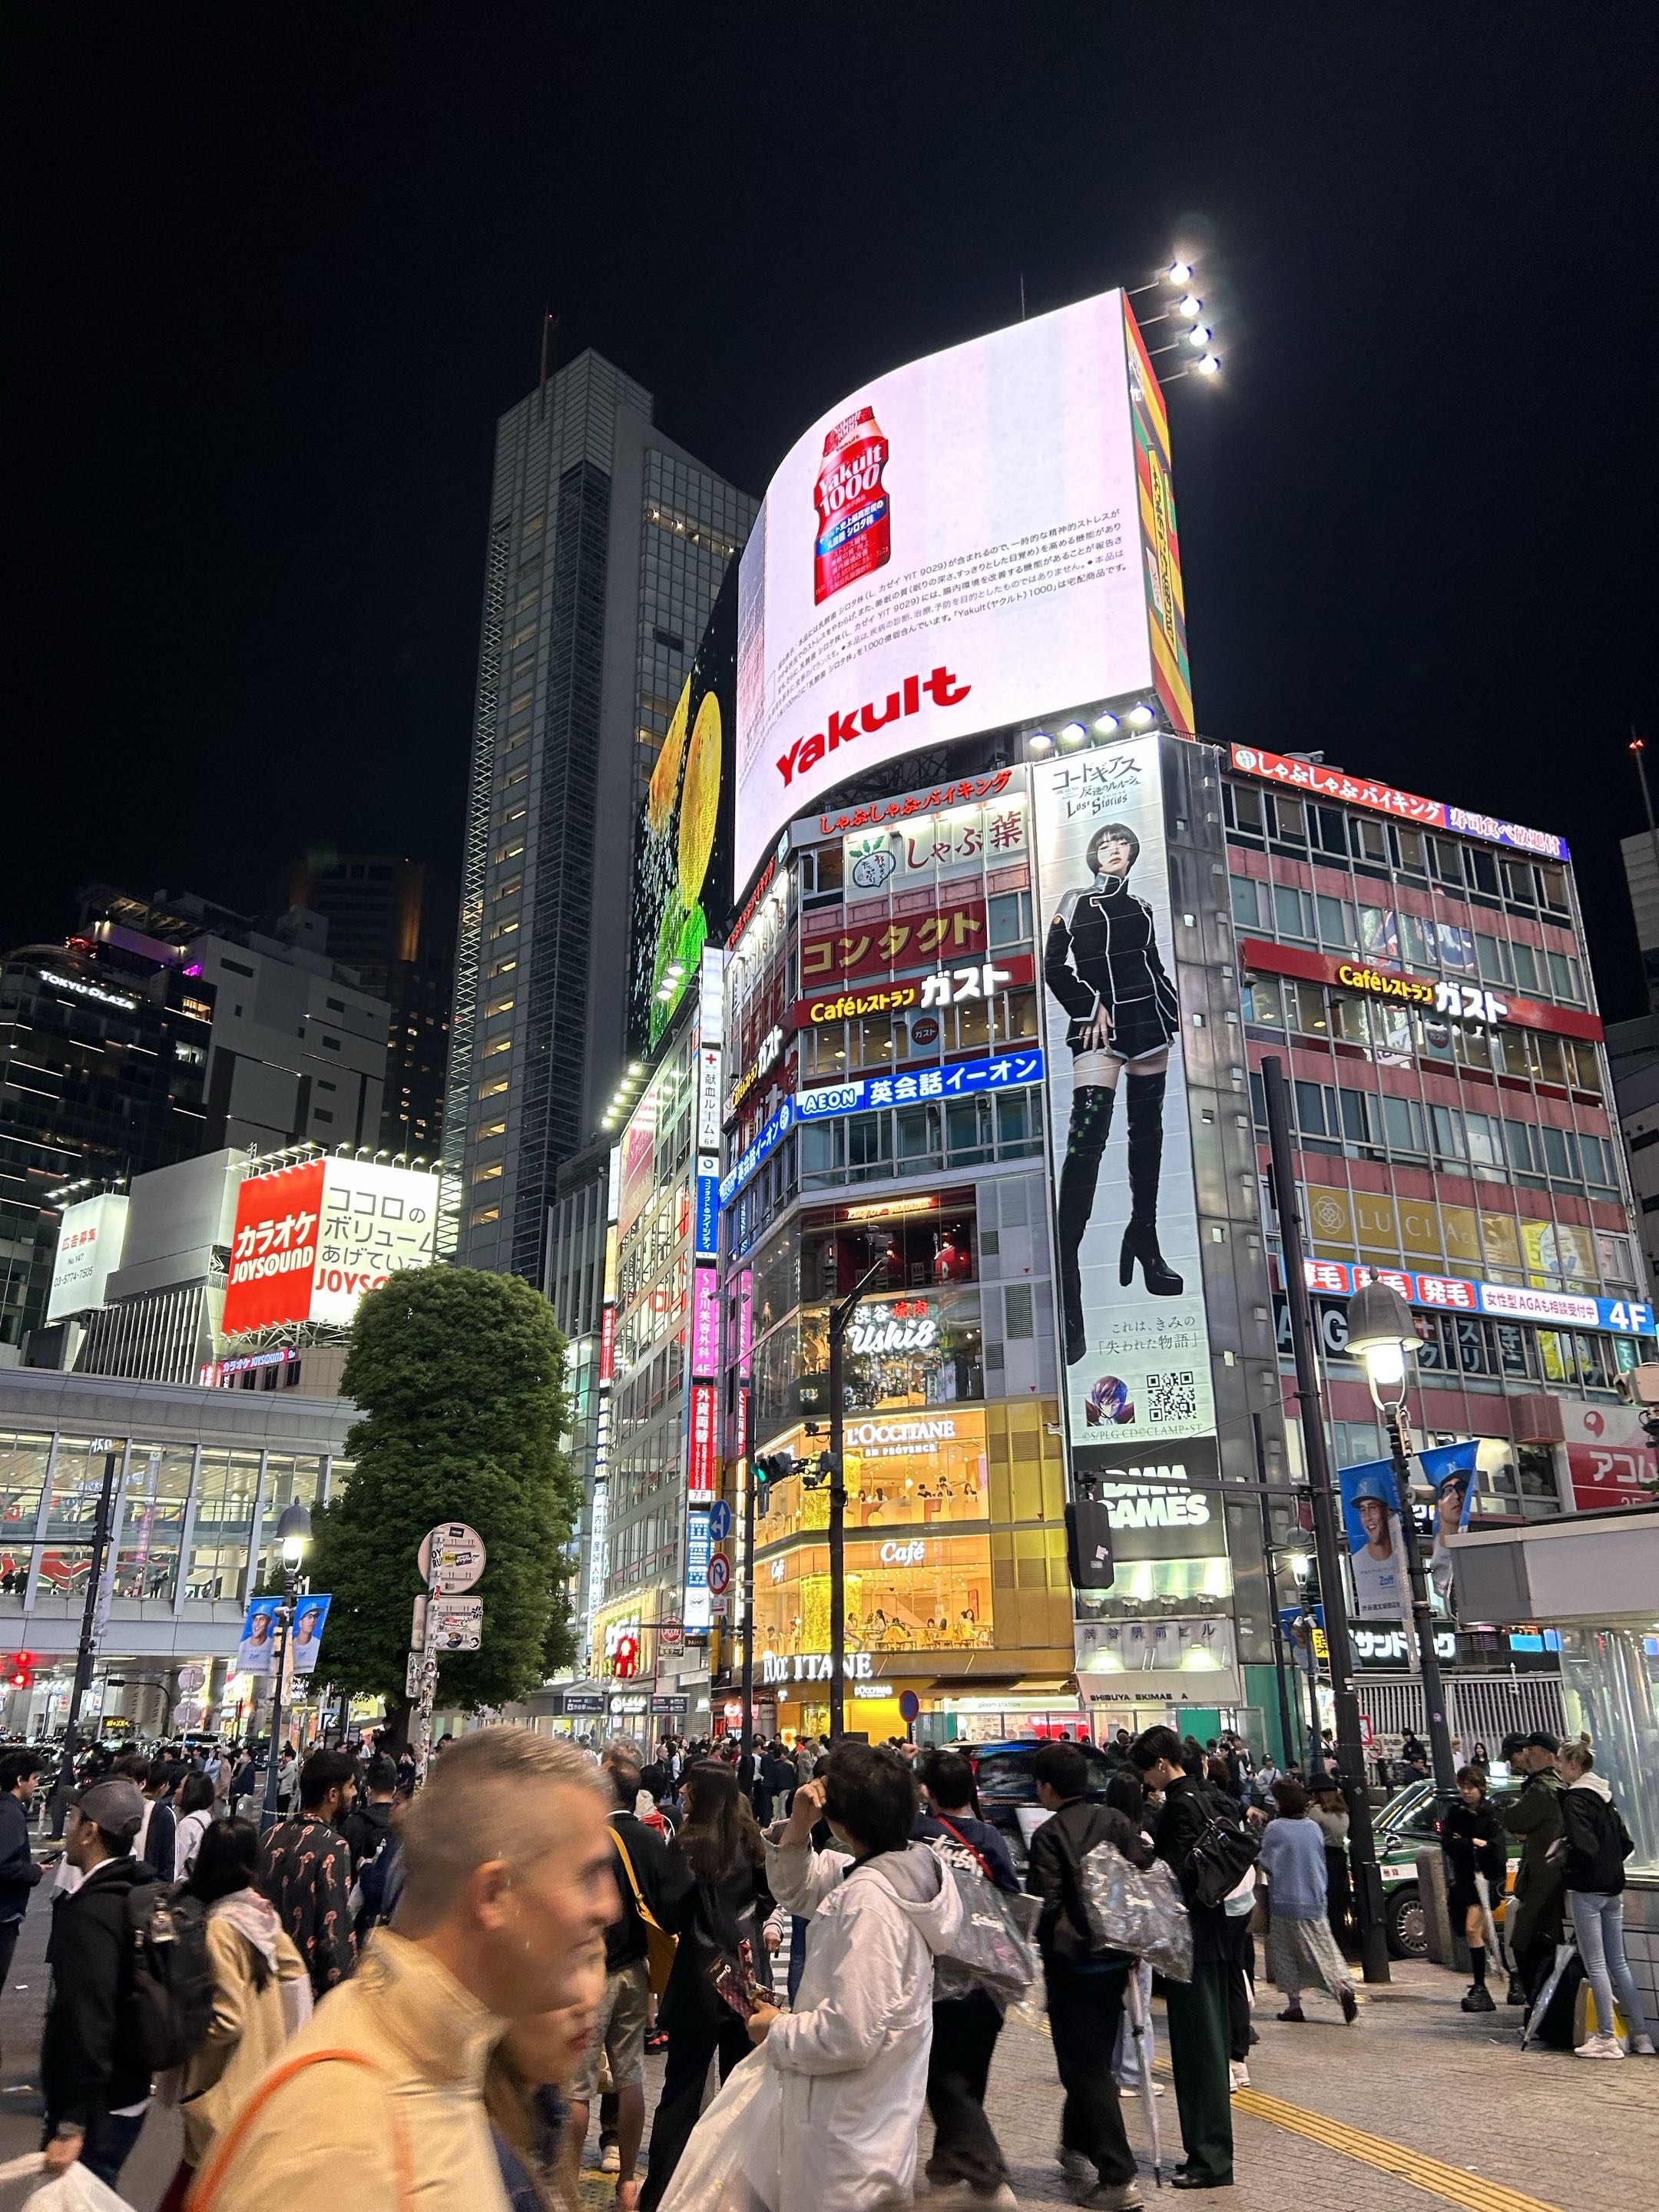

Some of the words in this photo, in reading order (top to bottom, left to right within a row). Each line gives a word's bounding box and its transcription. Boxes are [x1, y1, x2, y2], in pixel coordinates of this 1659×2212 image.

[820, 445, 882, 495] Yakult
[820, 463, 880, 518] 1000
[846, 515, 874, 537] シロタ株
[799, 611, 836, 645] 本品には乳酸菌
[879, 579, 900, 592] カゼイ
[904, 572, 916, 581] YIT
[854, 616, 874, 631] カゼイ
[878, 608, 891, 618] YIT
[775, 666, 971, 788] Yakult
[1052, 756, 1142, 790] コードギアス
[1079, 776, 1141, 799] 反逆のルルーシュ
[1257, 752, 1442, 821] しゃぶしゃぶバイキング
[820, 770, 1012, 835] しゃぶしゃぶバイキング
[1092, 794, 1128, 816] Stories
[907, 811, 1023, 869] しゃぶ葉
[803, 912, 982, 975] コンタクト
[38, 970, 87, 993] TOKYU
[810, 988, 915, 1023] Caféレストラン
[920, 963, 1012, 1008] ガスト
[1339, 965, 1434, 1003] Caféレストラン
[1435, 981, 1508, 1023] ガスト
[758, 1024, 784, 1079] ガスト
[915, 1028, 936, 1038] ガスト
[804, 1089, 856, 1113] AEON
[870, 1058, 1037, 1106] 英会話イーオン
[704, 1074, 716, 1135] 献血ルーム
[737, 1123, 779, 1185] 英会話イーオン
[327, 1187, 426, 1223] ココロの
[702, 1178, 711, 1250] コンタクトのアイシティ
[61, 1228, 96, 1251] 広告募集
[235, 1210, 317, 1260] カラオケ
[324, 1216, 435, 1253] ボリューム
[1358, 1209, 1459, 1242] LUCIA
[230, 1245, 314, 1285] JOYSOUND
[699, 1287, 710, 1359] 品川美容外科
[1113, 1316, 1195, 1333] これは、きみの
[1423, 1279, 1470, 1307] 発毛
[1486, 1292, 1595, 1320] 女性型AGAも相談受付中
[1609, 1302, 1647, 1333] 4F
[847, 1319, 936, 1354] Ushi8
[1099, 1333, 1198, 1355] 「失われた物語」
[223, 1359, 250, 1373] カラオケ
[250, 1351, 285, 1368] JOYSOUND
[696, 1364, 710, 1374] 4F
[695, 1389, 710, 1444] 外貨両替
[846, 1420, 955, 1446] L'OCCITANE
[1589, 1451, 1659, 1484] アコム
[880, 1541, 926, 1566] Café
[1379, 1575, 1394, 1586] Zoff
[1084, 1623, 1215, 1641] 渋谷駅前ビル
